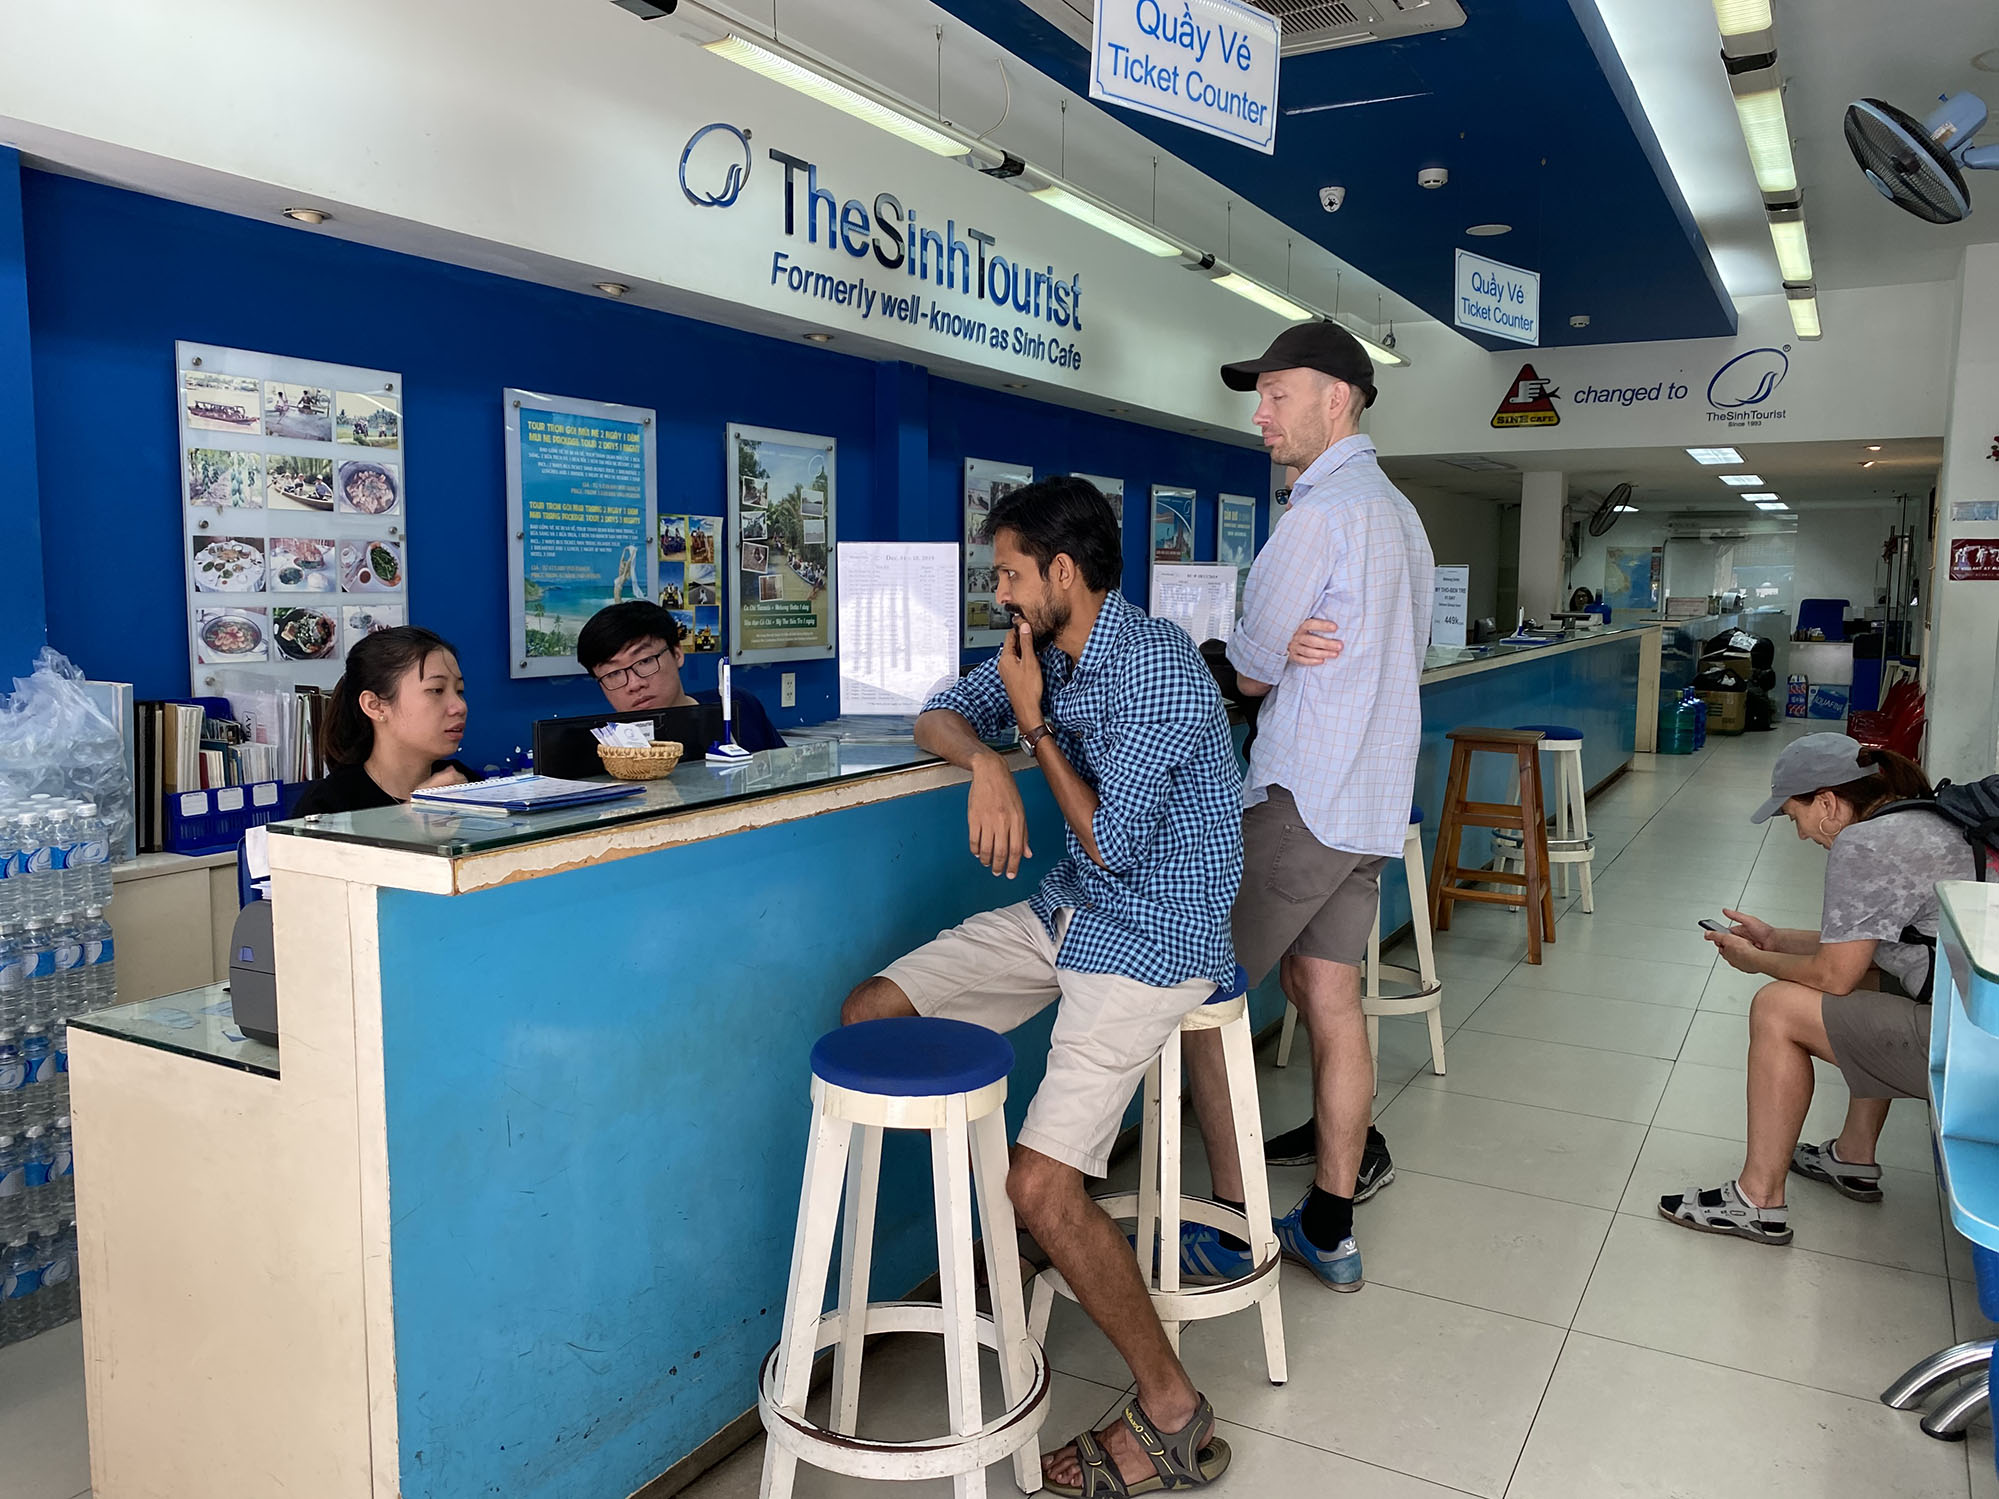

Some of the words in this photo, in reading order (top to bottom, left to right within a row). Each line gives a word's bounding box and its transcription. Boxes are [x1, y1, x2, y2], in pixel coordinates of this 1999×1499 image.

[1136, 0, 1211, 62] Quầy
[1219, 25, 1251, 71] Vé
[1108, 42, 1179, 95] Ticket
[1186, 71, 1267, 126] Counter
[769, 148, 1083, 331] TheSinhTourist
[771, 251, 876, 319] Formerly
[881, 292, 987, 345] well-known
[989, 327, 1009, 350] as
[1012, 326, 1045, 361] Sinh
[1048, 336, 1082, 371] Cafe
[1461, 297, 1491, 321] Ticket
[1493, 307, 1534, 332] Counter
[1472, 271, 1504, 303] Quầy
[1507, 280, 1525, 304] Vé
[1573, 383, 1663, 406] changed
[1667, 382, 1688, 400] to
